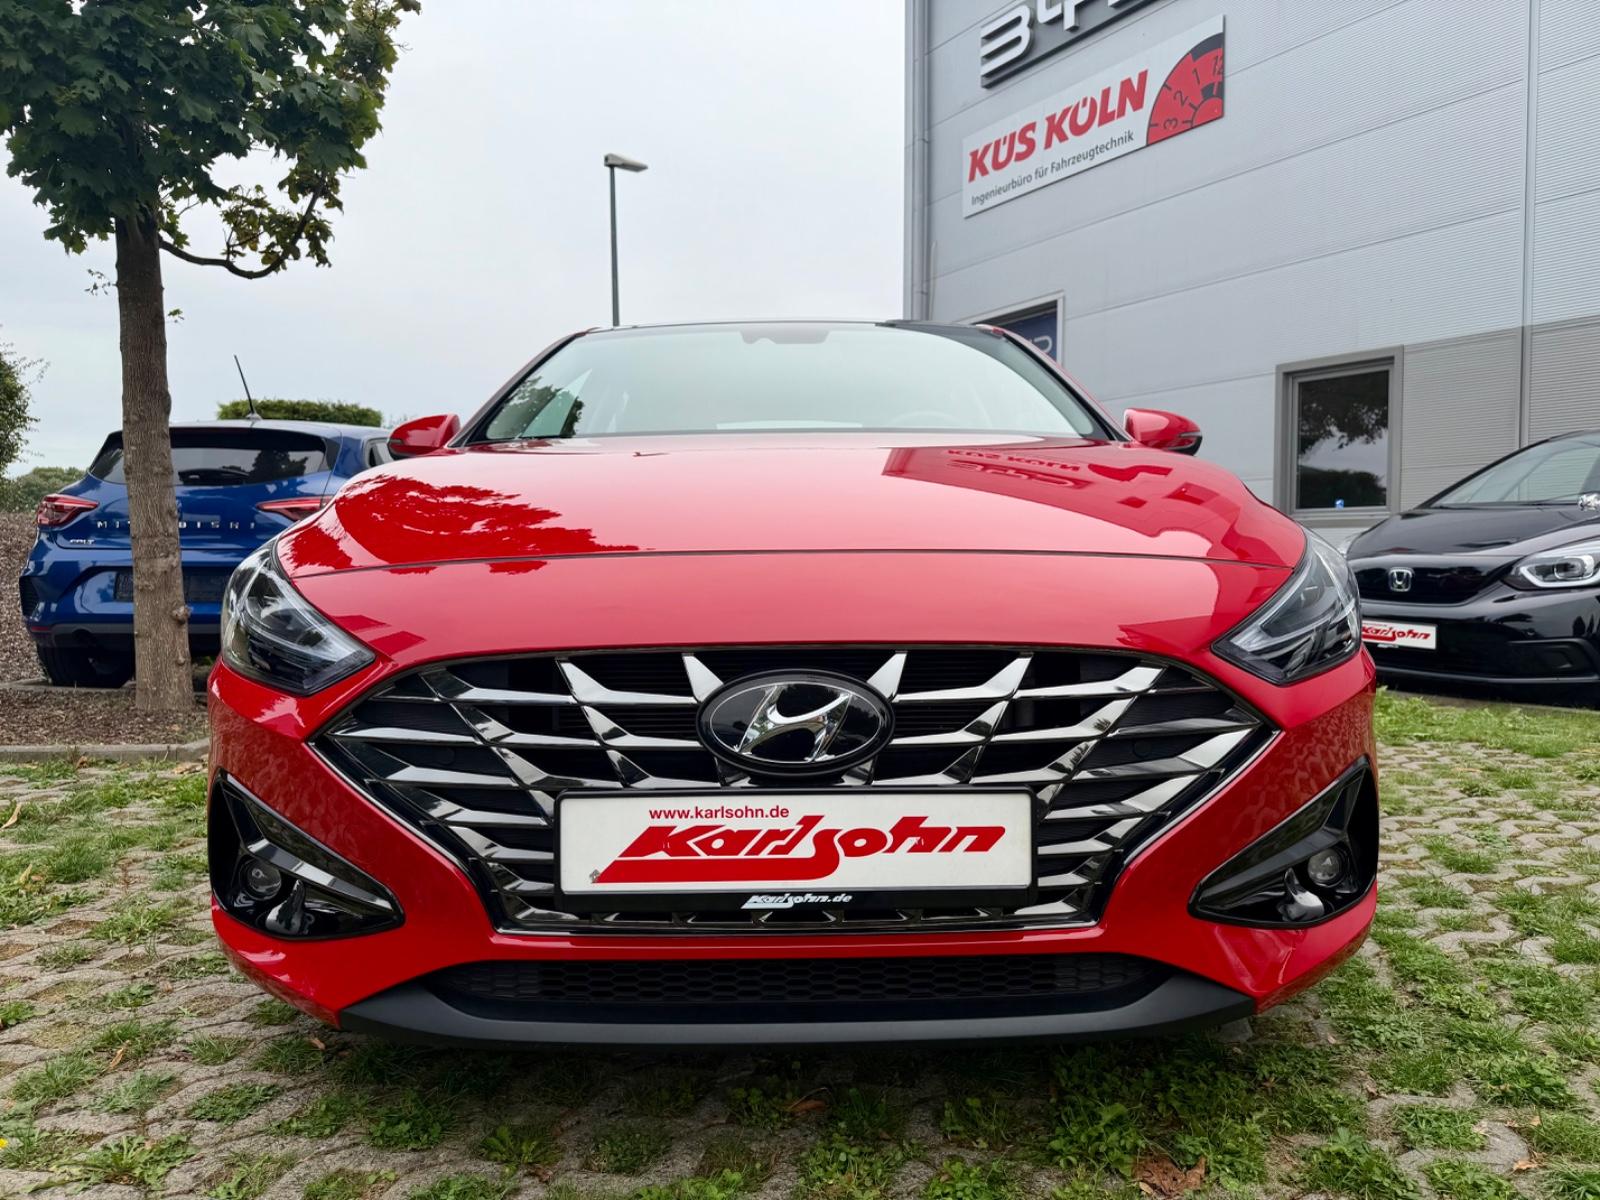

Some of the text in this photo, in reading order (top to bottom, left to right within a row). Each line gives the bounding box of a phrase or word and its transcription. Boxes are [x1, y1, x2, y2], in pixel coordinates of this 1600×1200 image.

[980, 0, 1126, 78] BY
[1173, 90, 1188, 107] 2
[968, 69, 1148, 182] KÜS KÖLN
[1163, 118, 1178, 130] 3
[971, 130, 1134, 206] Ingenieurbüro für Fahrzeugtechnik
[97, 520, 255, 530] MIBISHI
[649, 805, 790, 819] www.karlsohn.de
[593, 814, 1006, 884] Karlsohn
[741, 893, 853, 909] Karlsohn.de
